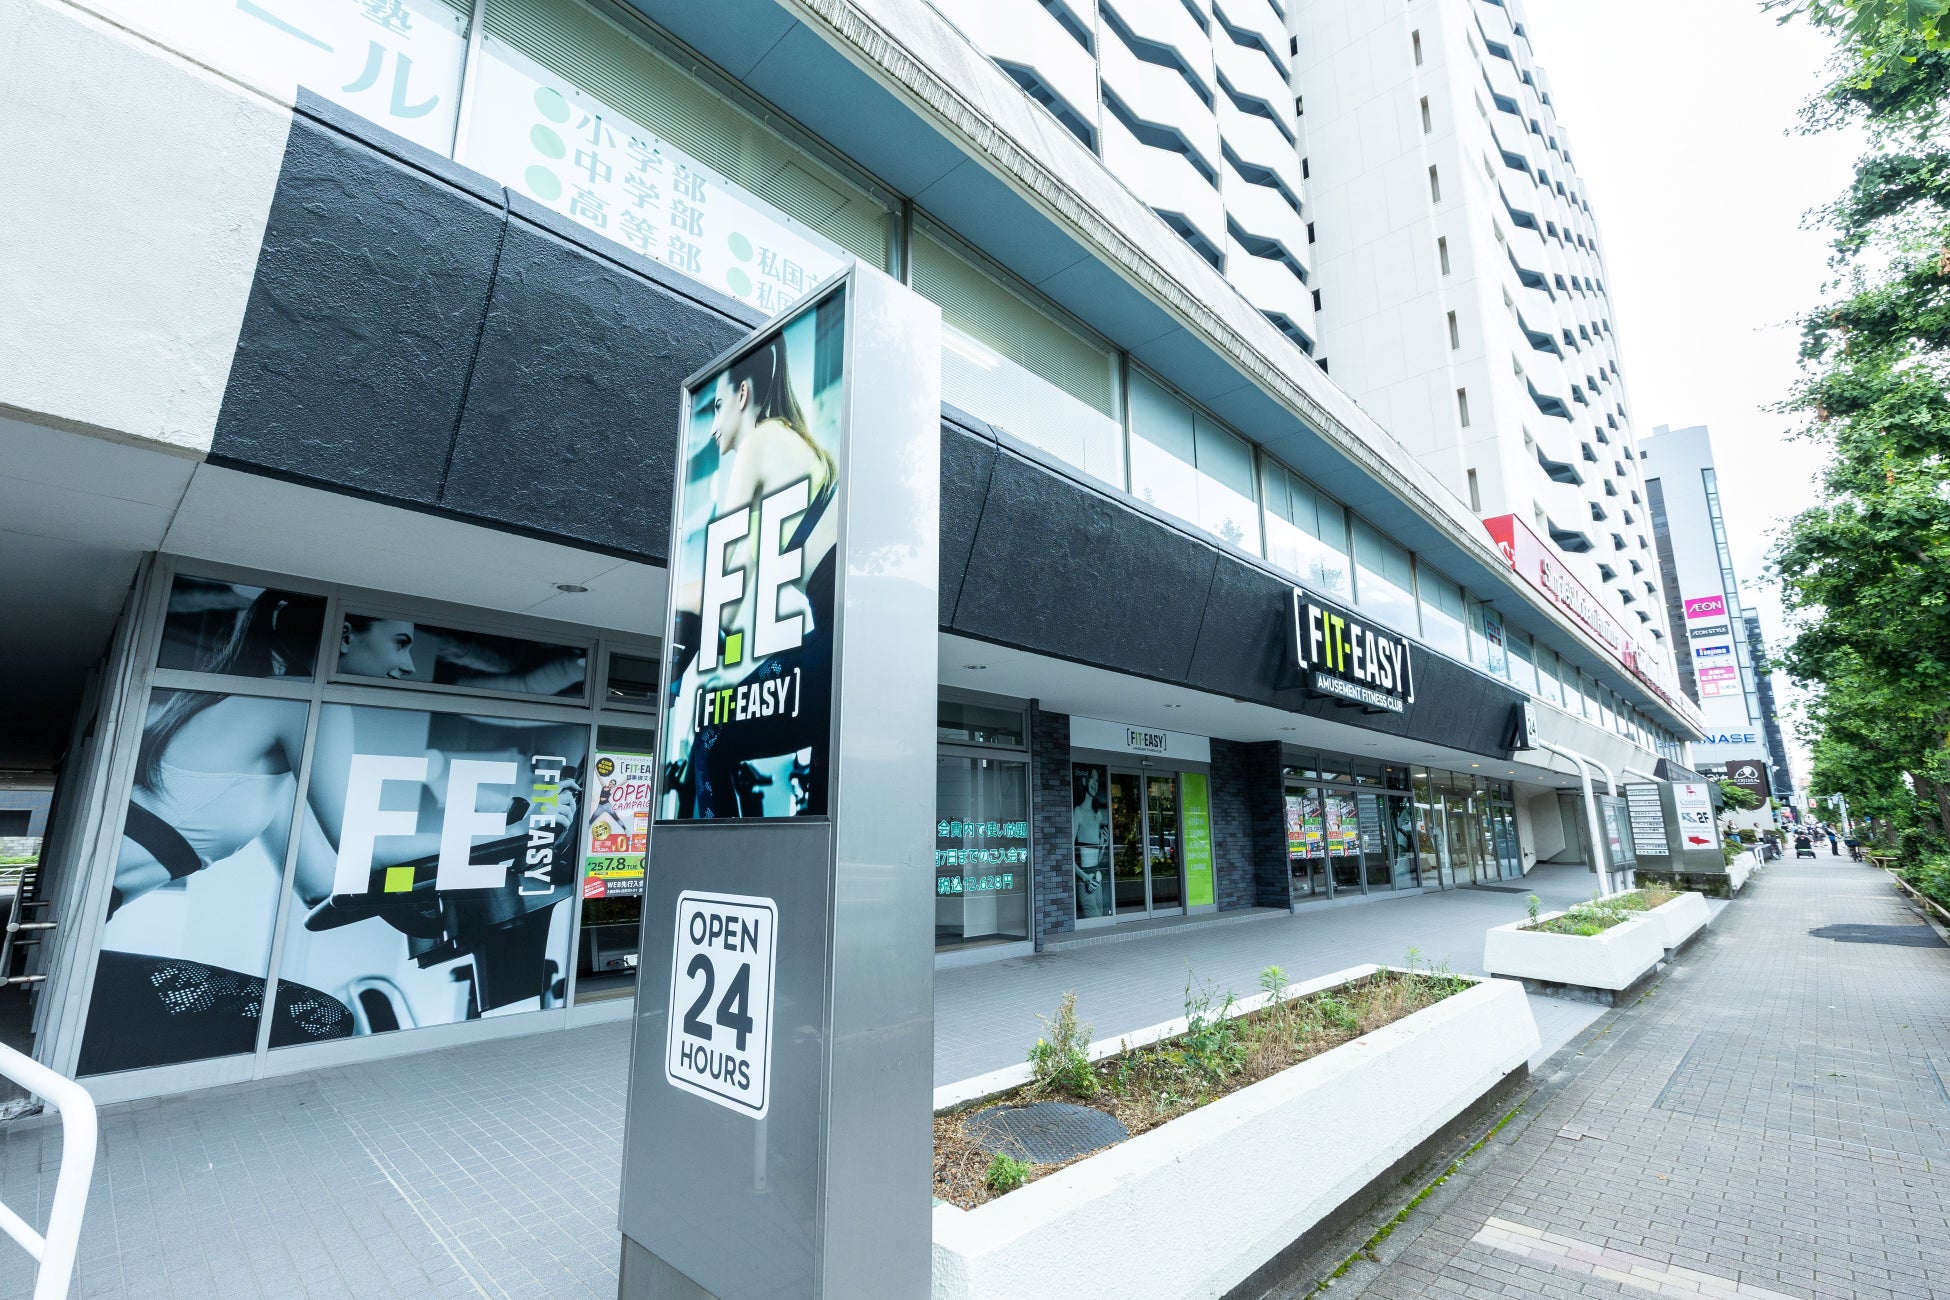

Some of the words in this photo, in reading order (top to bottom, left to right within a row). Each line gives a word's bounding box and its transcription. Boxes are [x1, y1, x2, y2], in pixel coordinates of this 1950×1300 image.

[575, 115, 707, 203] 小学部
[574, 149, 705, 238] 中学部
[569, 183, 702, 274] 高等部
[1317, 674, 1361, 700] AMUSEMENT
[1361, 688, 1387, 707] FITNESS
[1387, 697, 1404, 712] CLUB
[937, 819, 1028, 839] 会費内で使い放題
[1696, 811, 1710, 824] 2F
[689, 911, 760, 955] OPEN
[683, 953, 754, 1052] 24
[680, 1040, 751, 1091] HOURS
